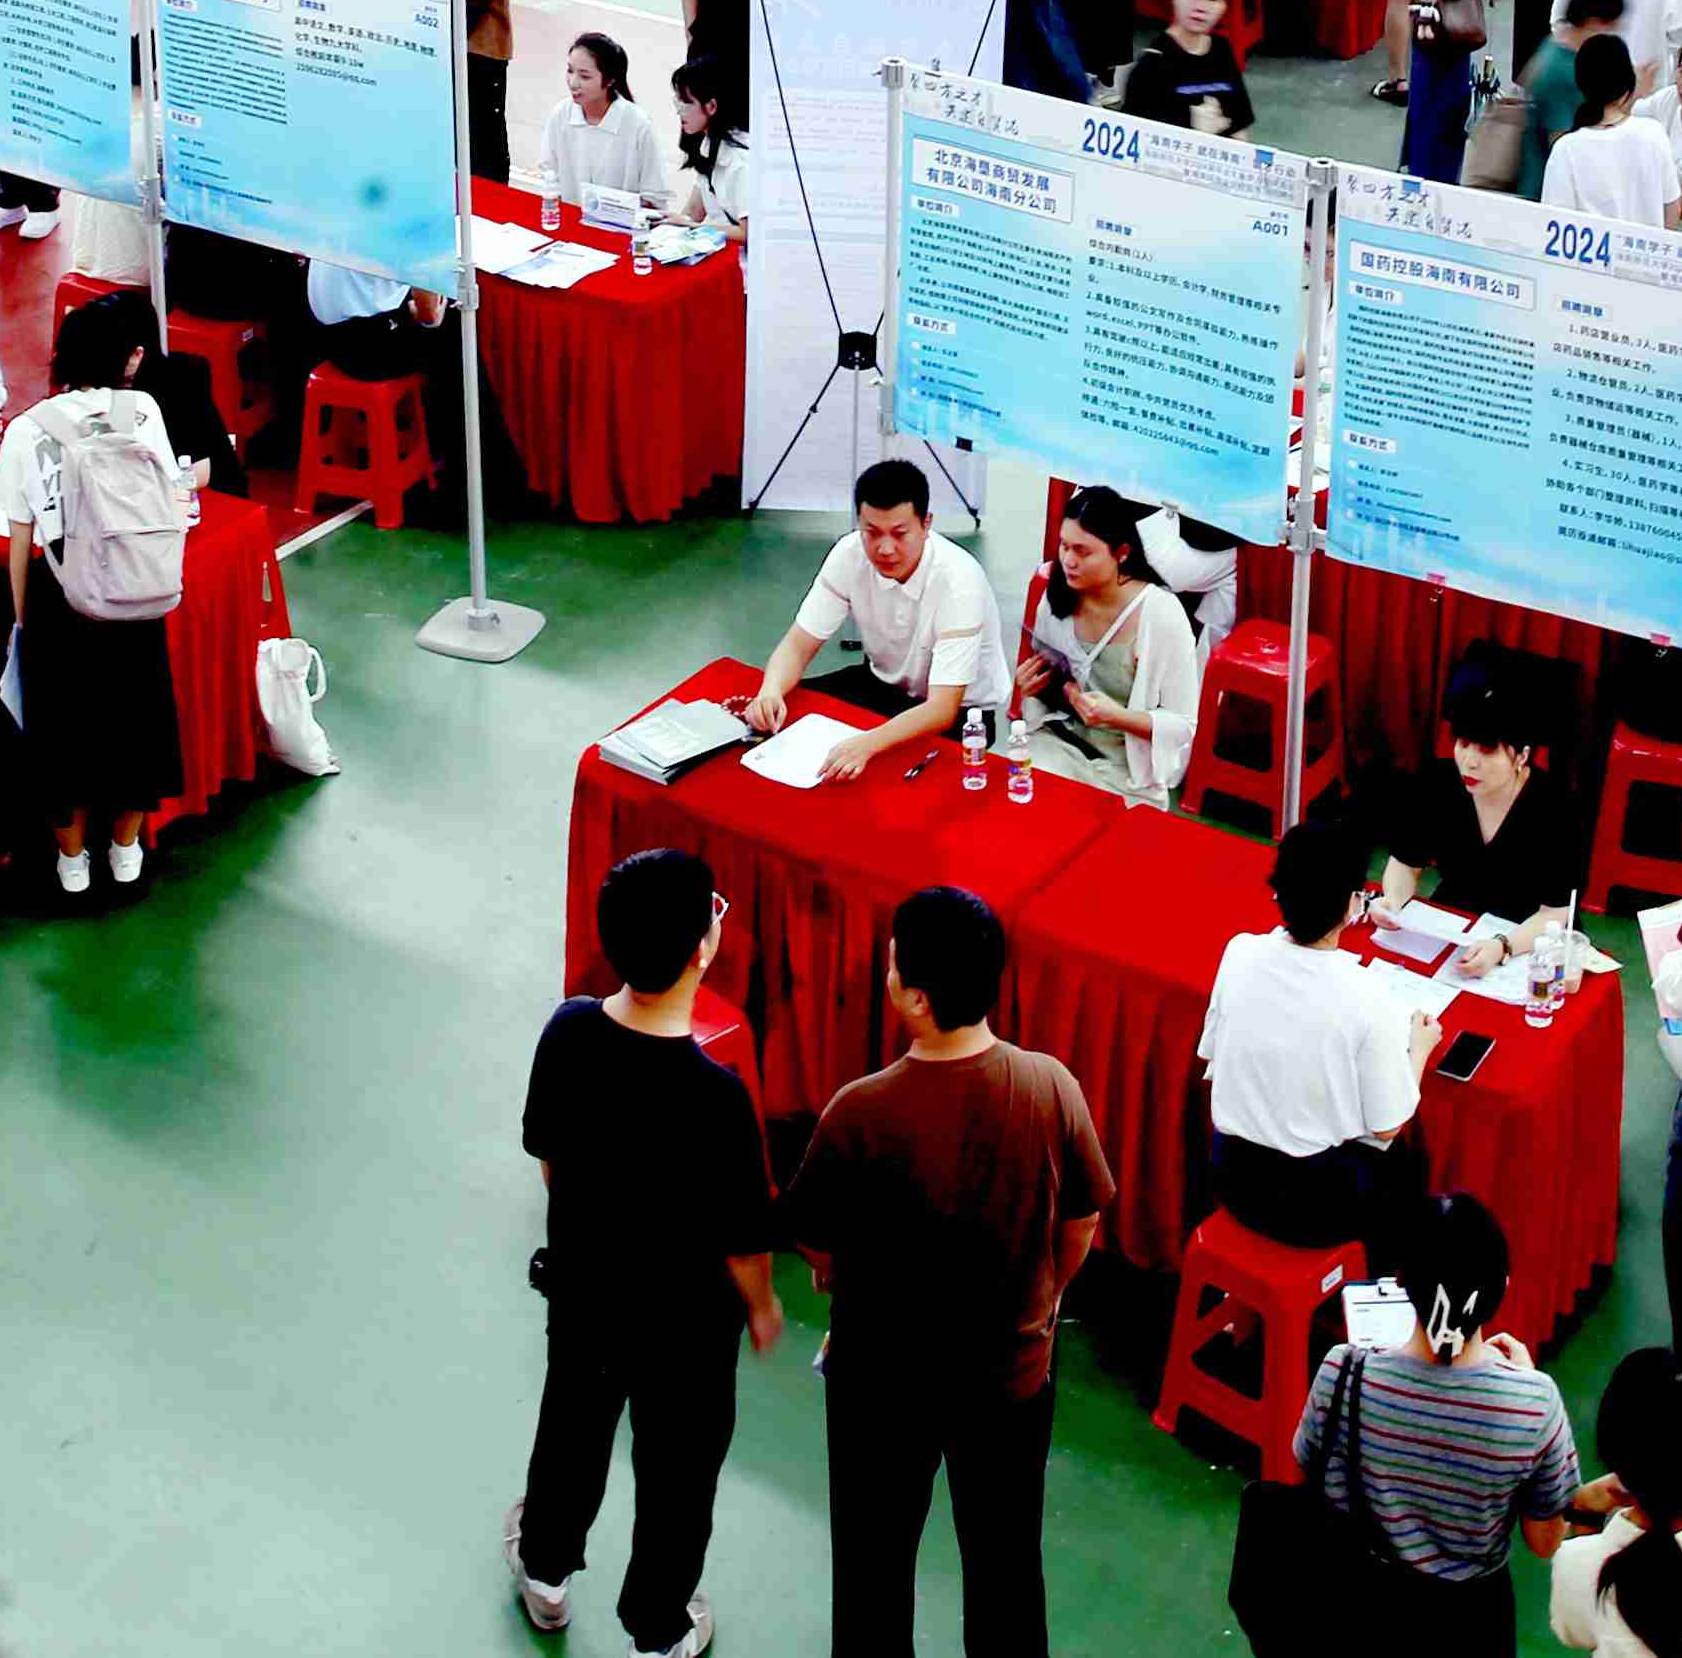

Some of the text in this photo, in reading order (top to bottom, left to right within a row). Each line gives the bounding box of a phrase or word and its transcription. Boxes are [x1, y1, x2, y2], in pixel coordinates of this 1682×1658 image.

[414, 13, 440, 30] A002
[1082, 117, 1140, 165] 2024
[926, 167, 1057, 215] 有限公司海南分公司
[1252, 220, 1289, 238] A001
[1544, 219, 1612, 268] 2024
[1359, 249, 1522, 303] 国药控股海南有限公司
